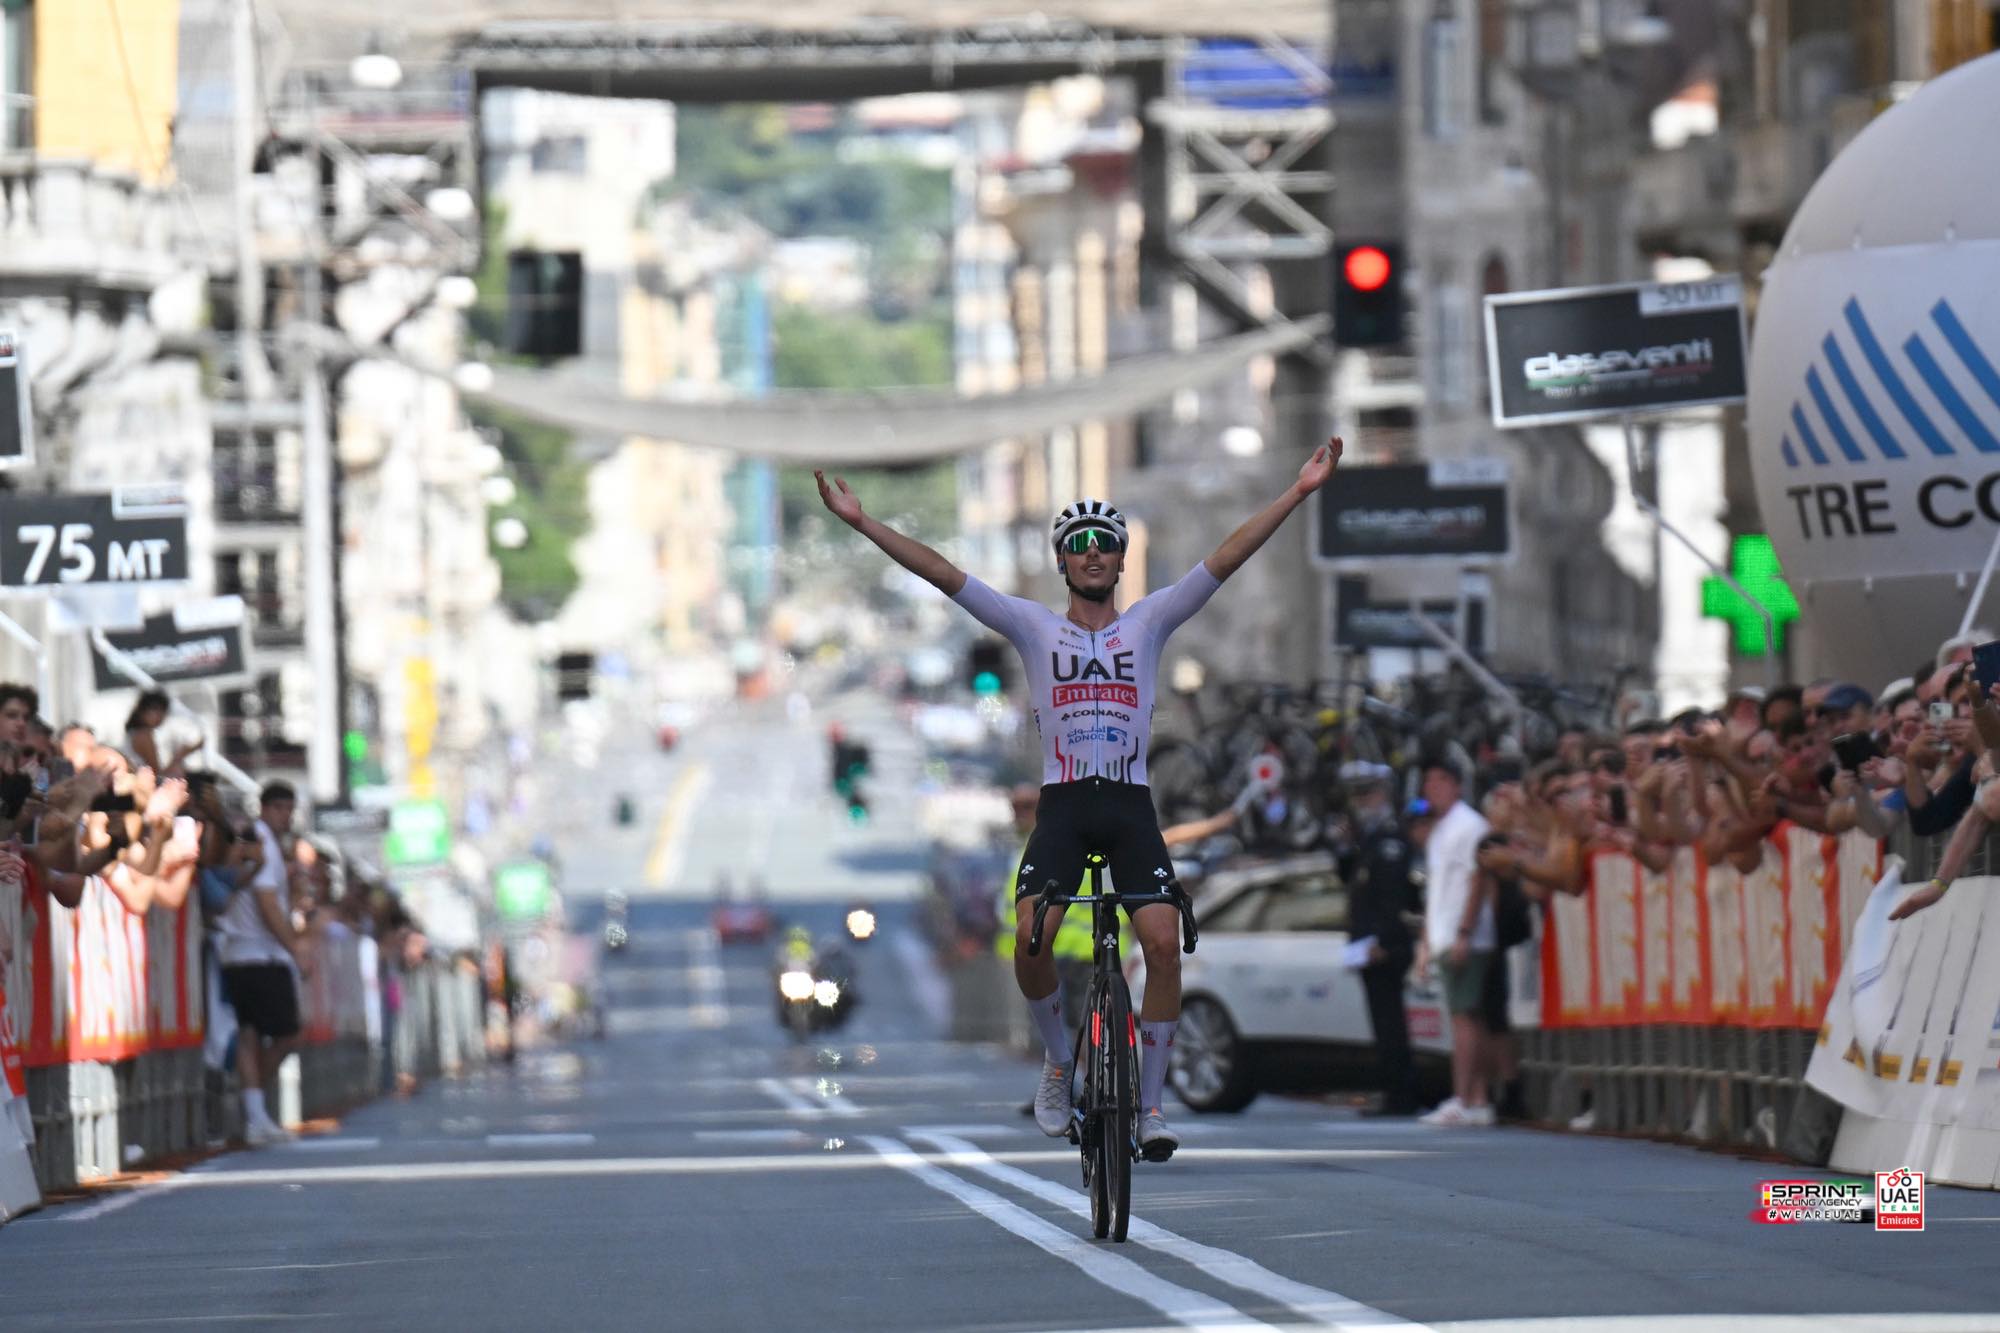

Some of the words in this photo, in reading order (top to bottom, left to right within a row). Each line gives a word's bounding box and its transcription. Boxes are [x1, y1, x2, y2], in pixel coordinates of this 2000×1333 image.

[1786, 479, 1897, 541] TRE
[17, 523, 96, 584] 75
[107, 539, 170, 580] MT
[1052, 650, 1135, 681] UAE
[1055, 686, 1136, 705] Emirates
[1072, 709, 1131, 722] COLNAGO
[1068, 733, 1106, 745] ADNOC
